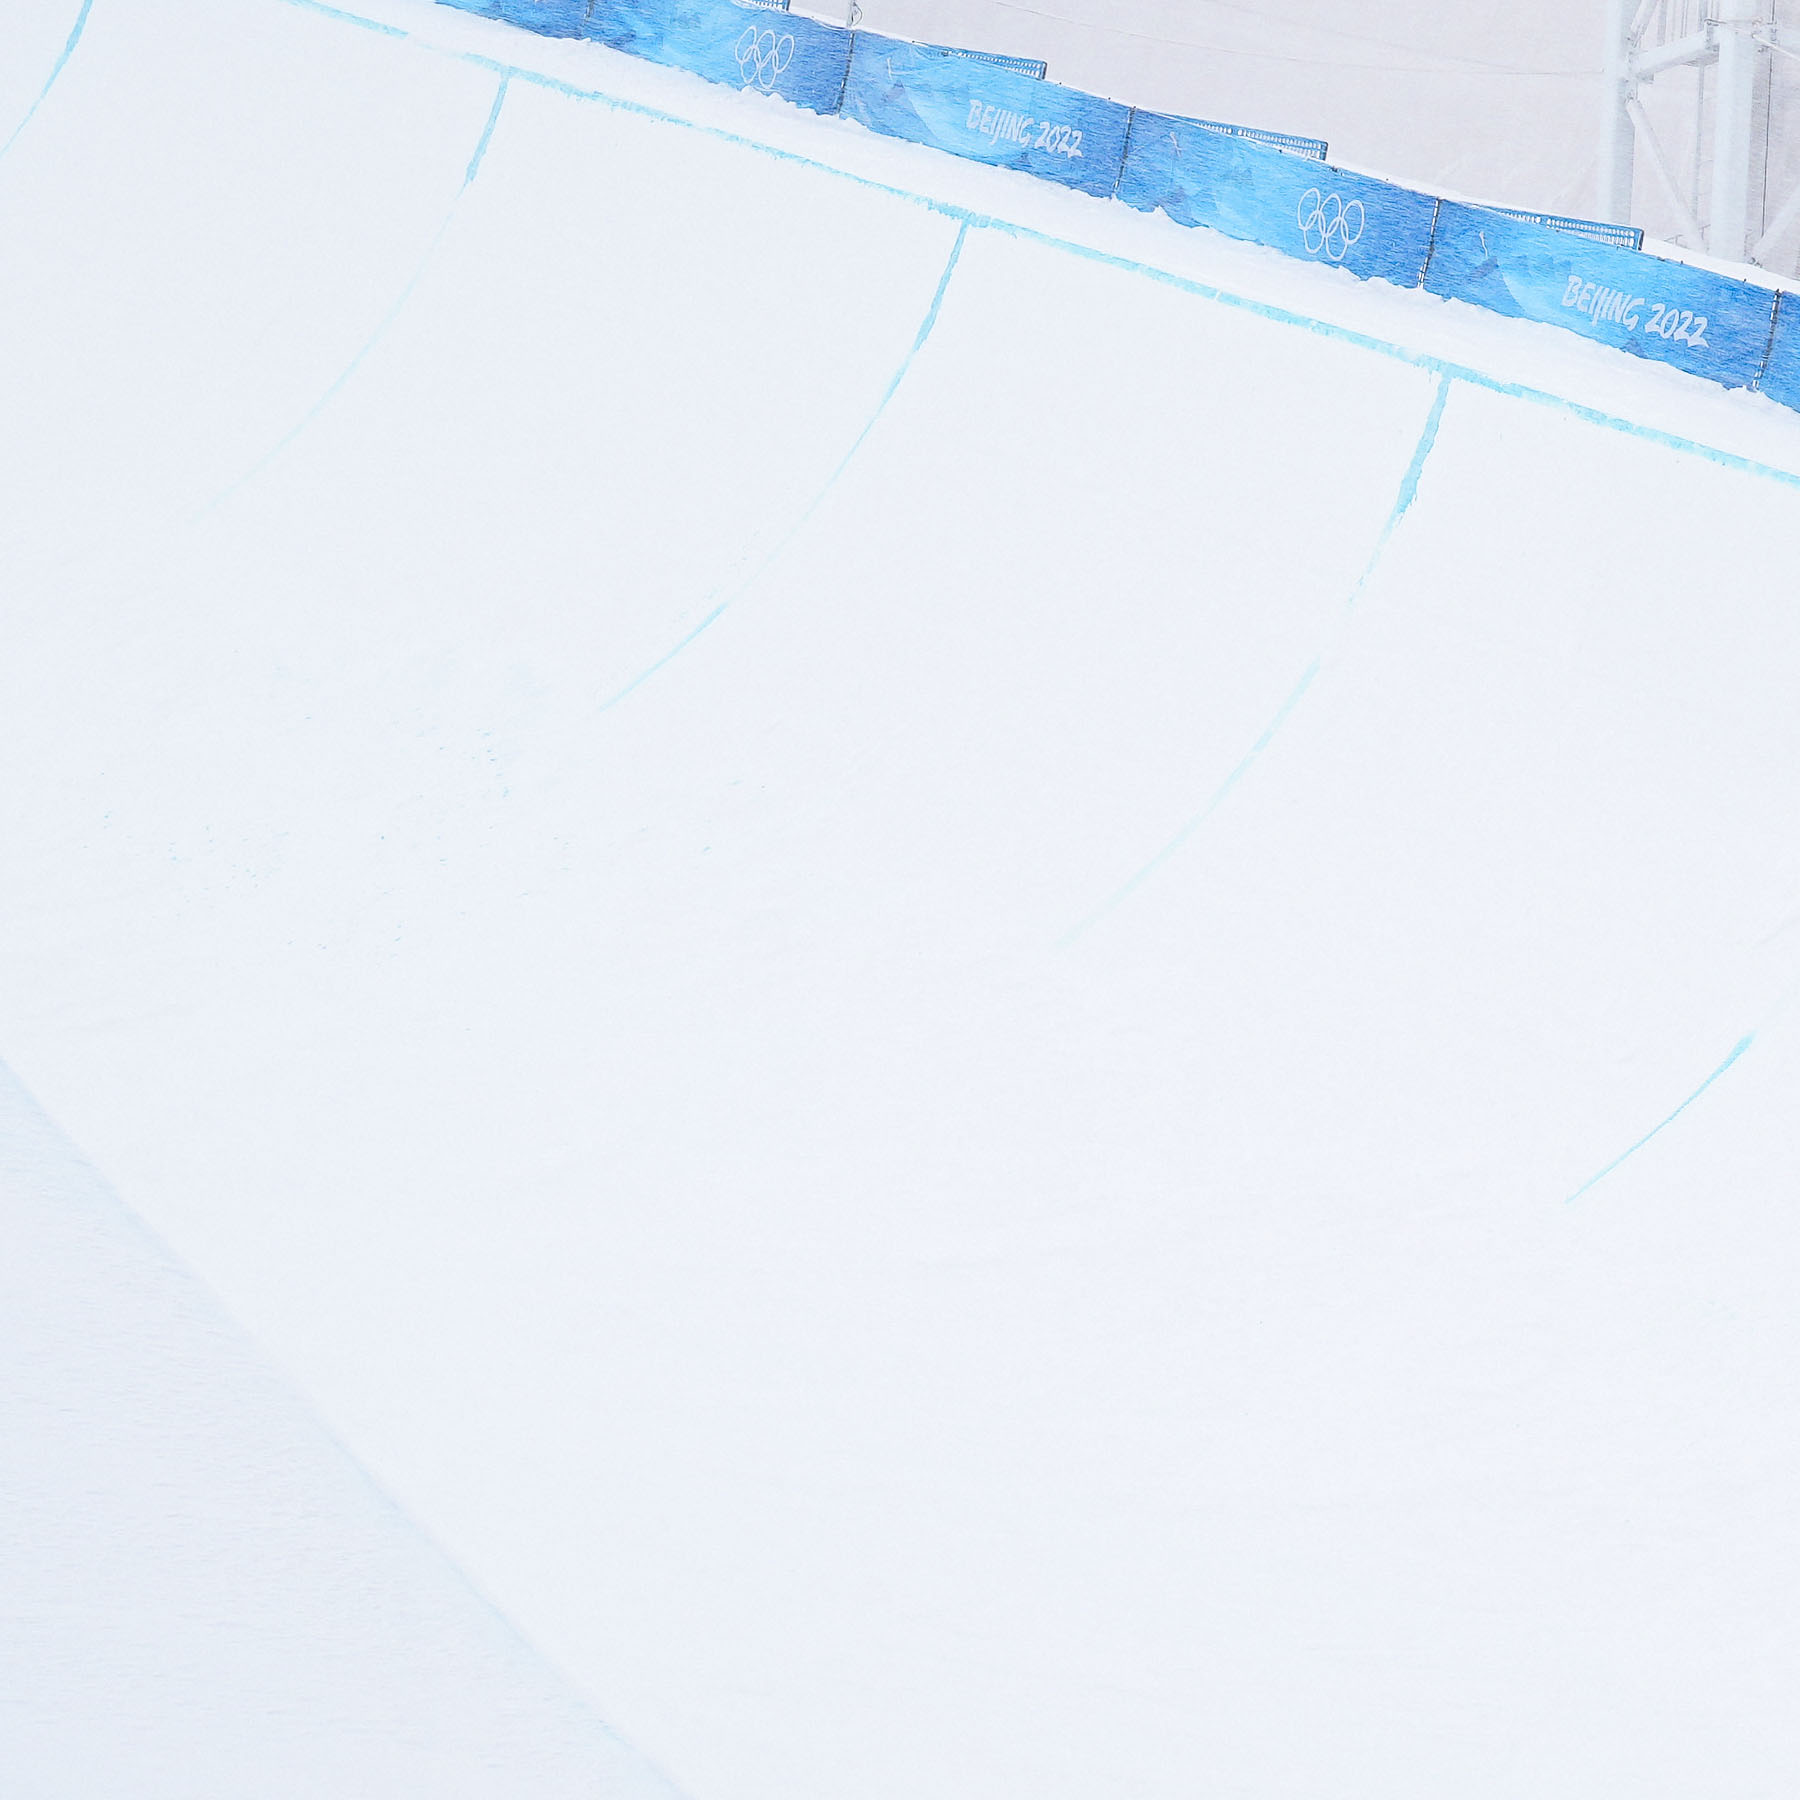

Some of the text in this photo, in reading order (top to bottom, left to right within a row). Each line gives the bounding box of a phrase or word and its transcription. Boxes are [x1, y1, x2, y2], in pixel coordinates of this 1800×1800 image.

[966, 99, 1083, 159] BEIJING 2022
[1561, 275, 1709, 348] BEIJING 2022
